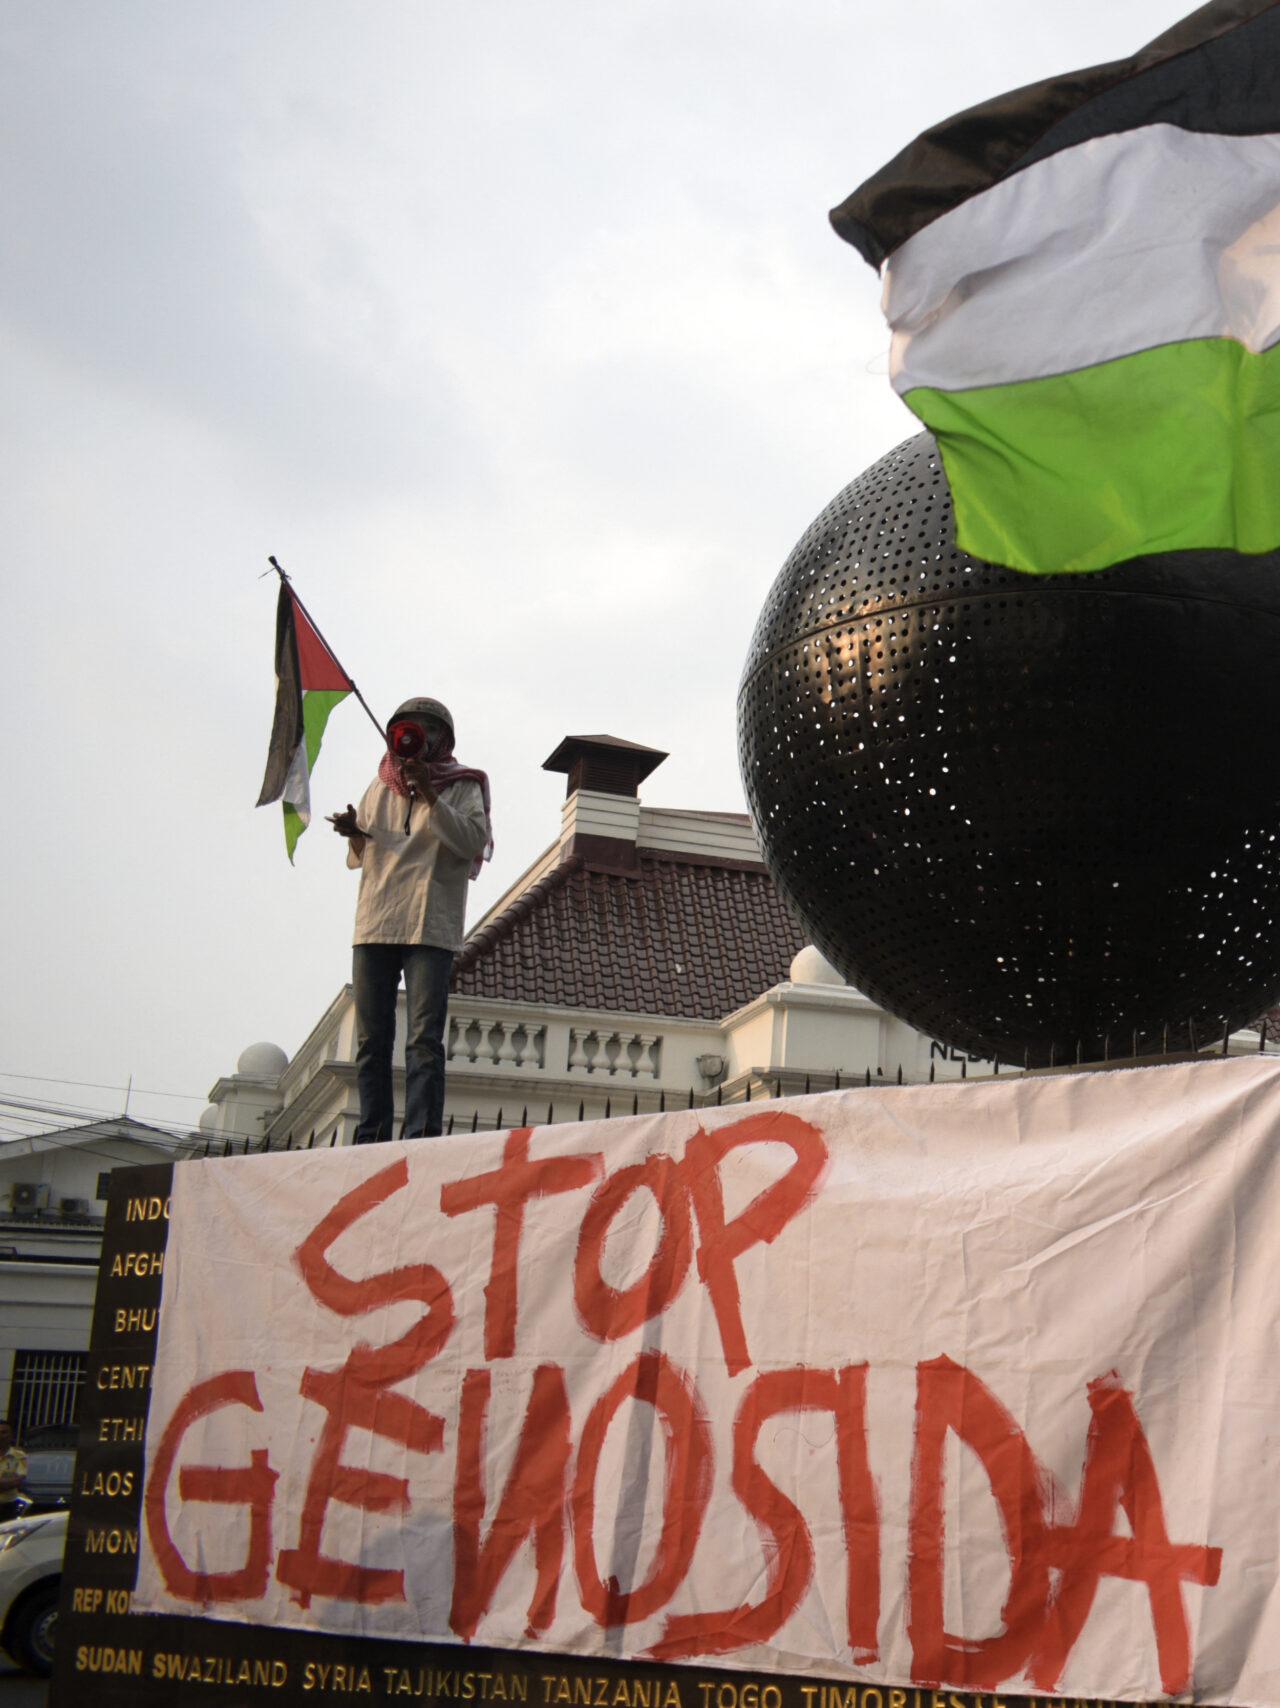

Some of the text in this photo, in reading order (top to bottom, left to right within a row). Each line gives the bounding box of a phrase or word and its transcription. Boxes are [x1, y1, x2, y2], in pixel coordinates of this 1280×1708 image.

[293, 1110, 829, 1386] STOP
[110, 1252, 164, 1277] AFGH
[81, 1471, 134, 1496] LAOS
[73, 1587, 103, 1613] REP
[75, 1646, 143, 1675] SUDAN
[152, 1652, 288, 1687] SWAZILAND
[303, 1662, 372, 1693] SYRIA
[384, 1668, 529, 1701] TAJIKISTAN
[541, 1675, 682, 1708] TANZANIA
[698, 1682, 782, 1708] TOGO
